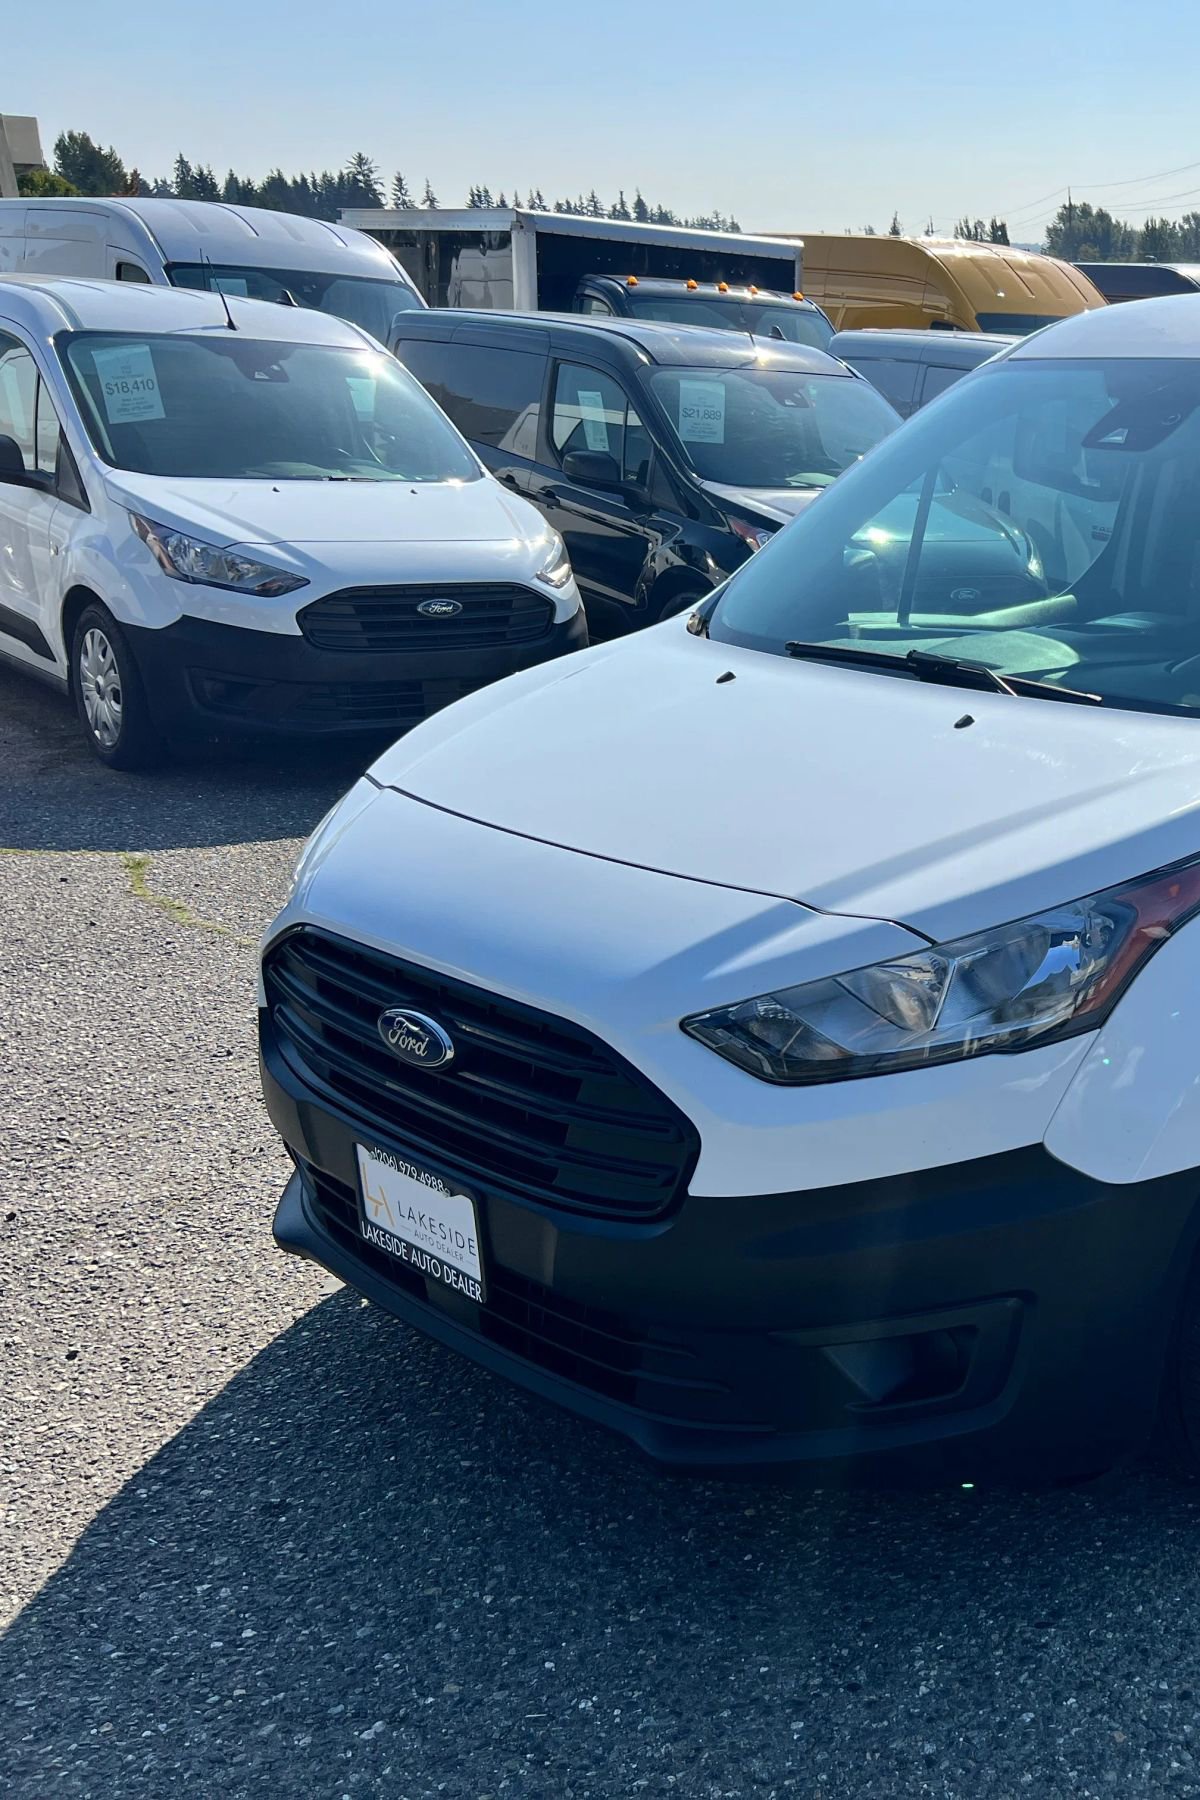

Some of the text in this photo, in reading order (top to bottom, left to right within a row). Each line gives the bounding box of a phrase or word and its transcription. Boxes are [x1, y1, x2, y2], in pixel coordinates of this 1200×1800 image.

[105, 378, 155, 396] $18,410
[681, 407, 722, 421] $21,889
[397, 1199, 477, 1257] LAKESIDE
[361, 1220, 483, 1303] LAKESIDE AUTO DEALER
[414, 1229, 465, 1262] AUTO DEALER
